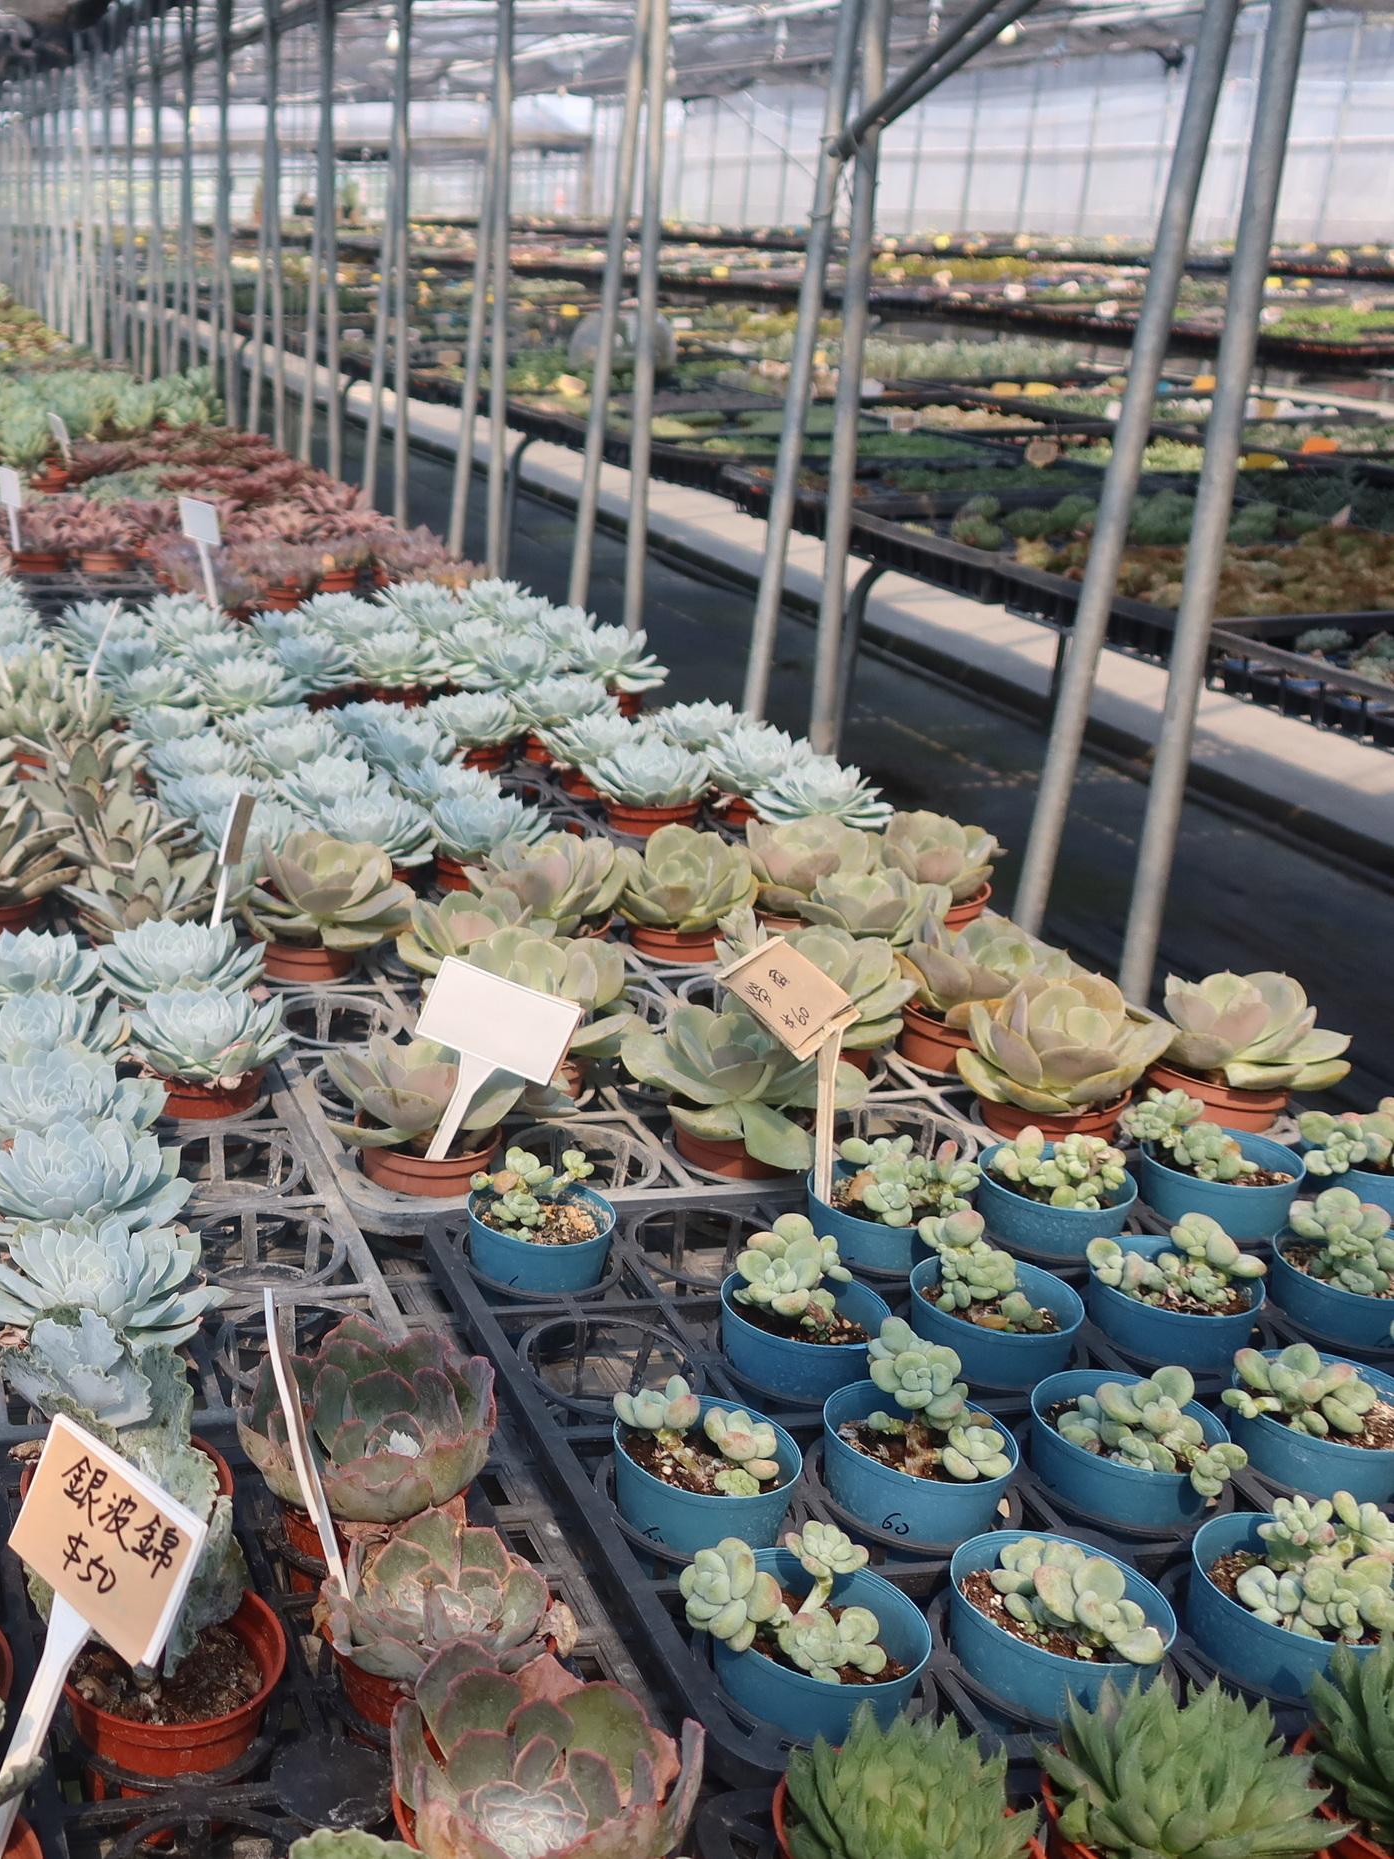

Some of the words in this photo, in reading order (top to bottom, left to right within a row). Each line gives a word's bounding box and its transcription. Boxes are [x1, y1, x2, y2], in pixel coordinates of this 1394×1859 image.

[779, 1006, 810, 1029] $60
[61, 1456, 181, 1578] 銀波錦
[62, 1532, 117, 1594] $50
